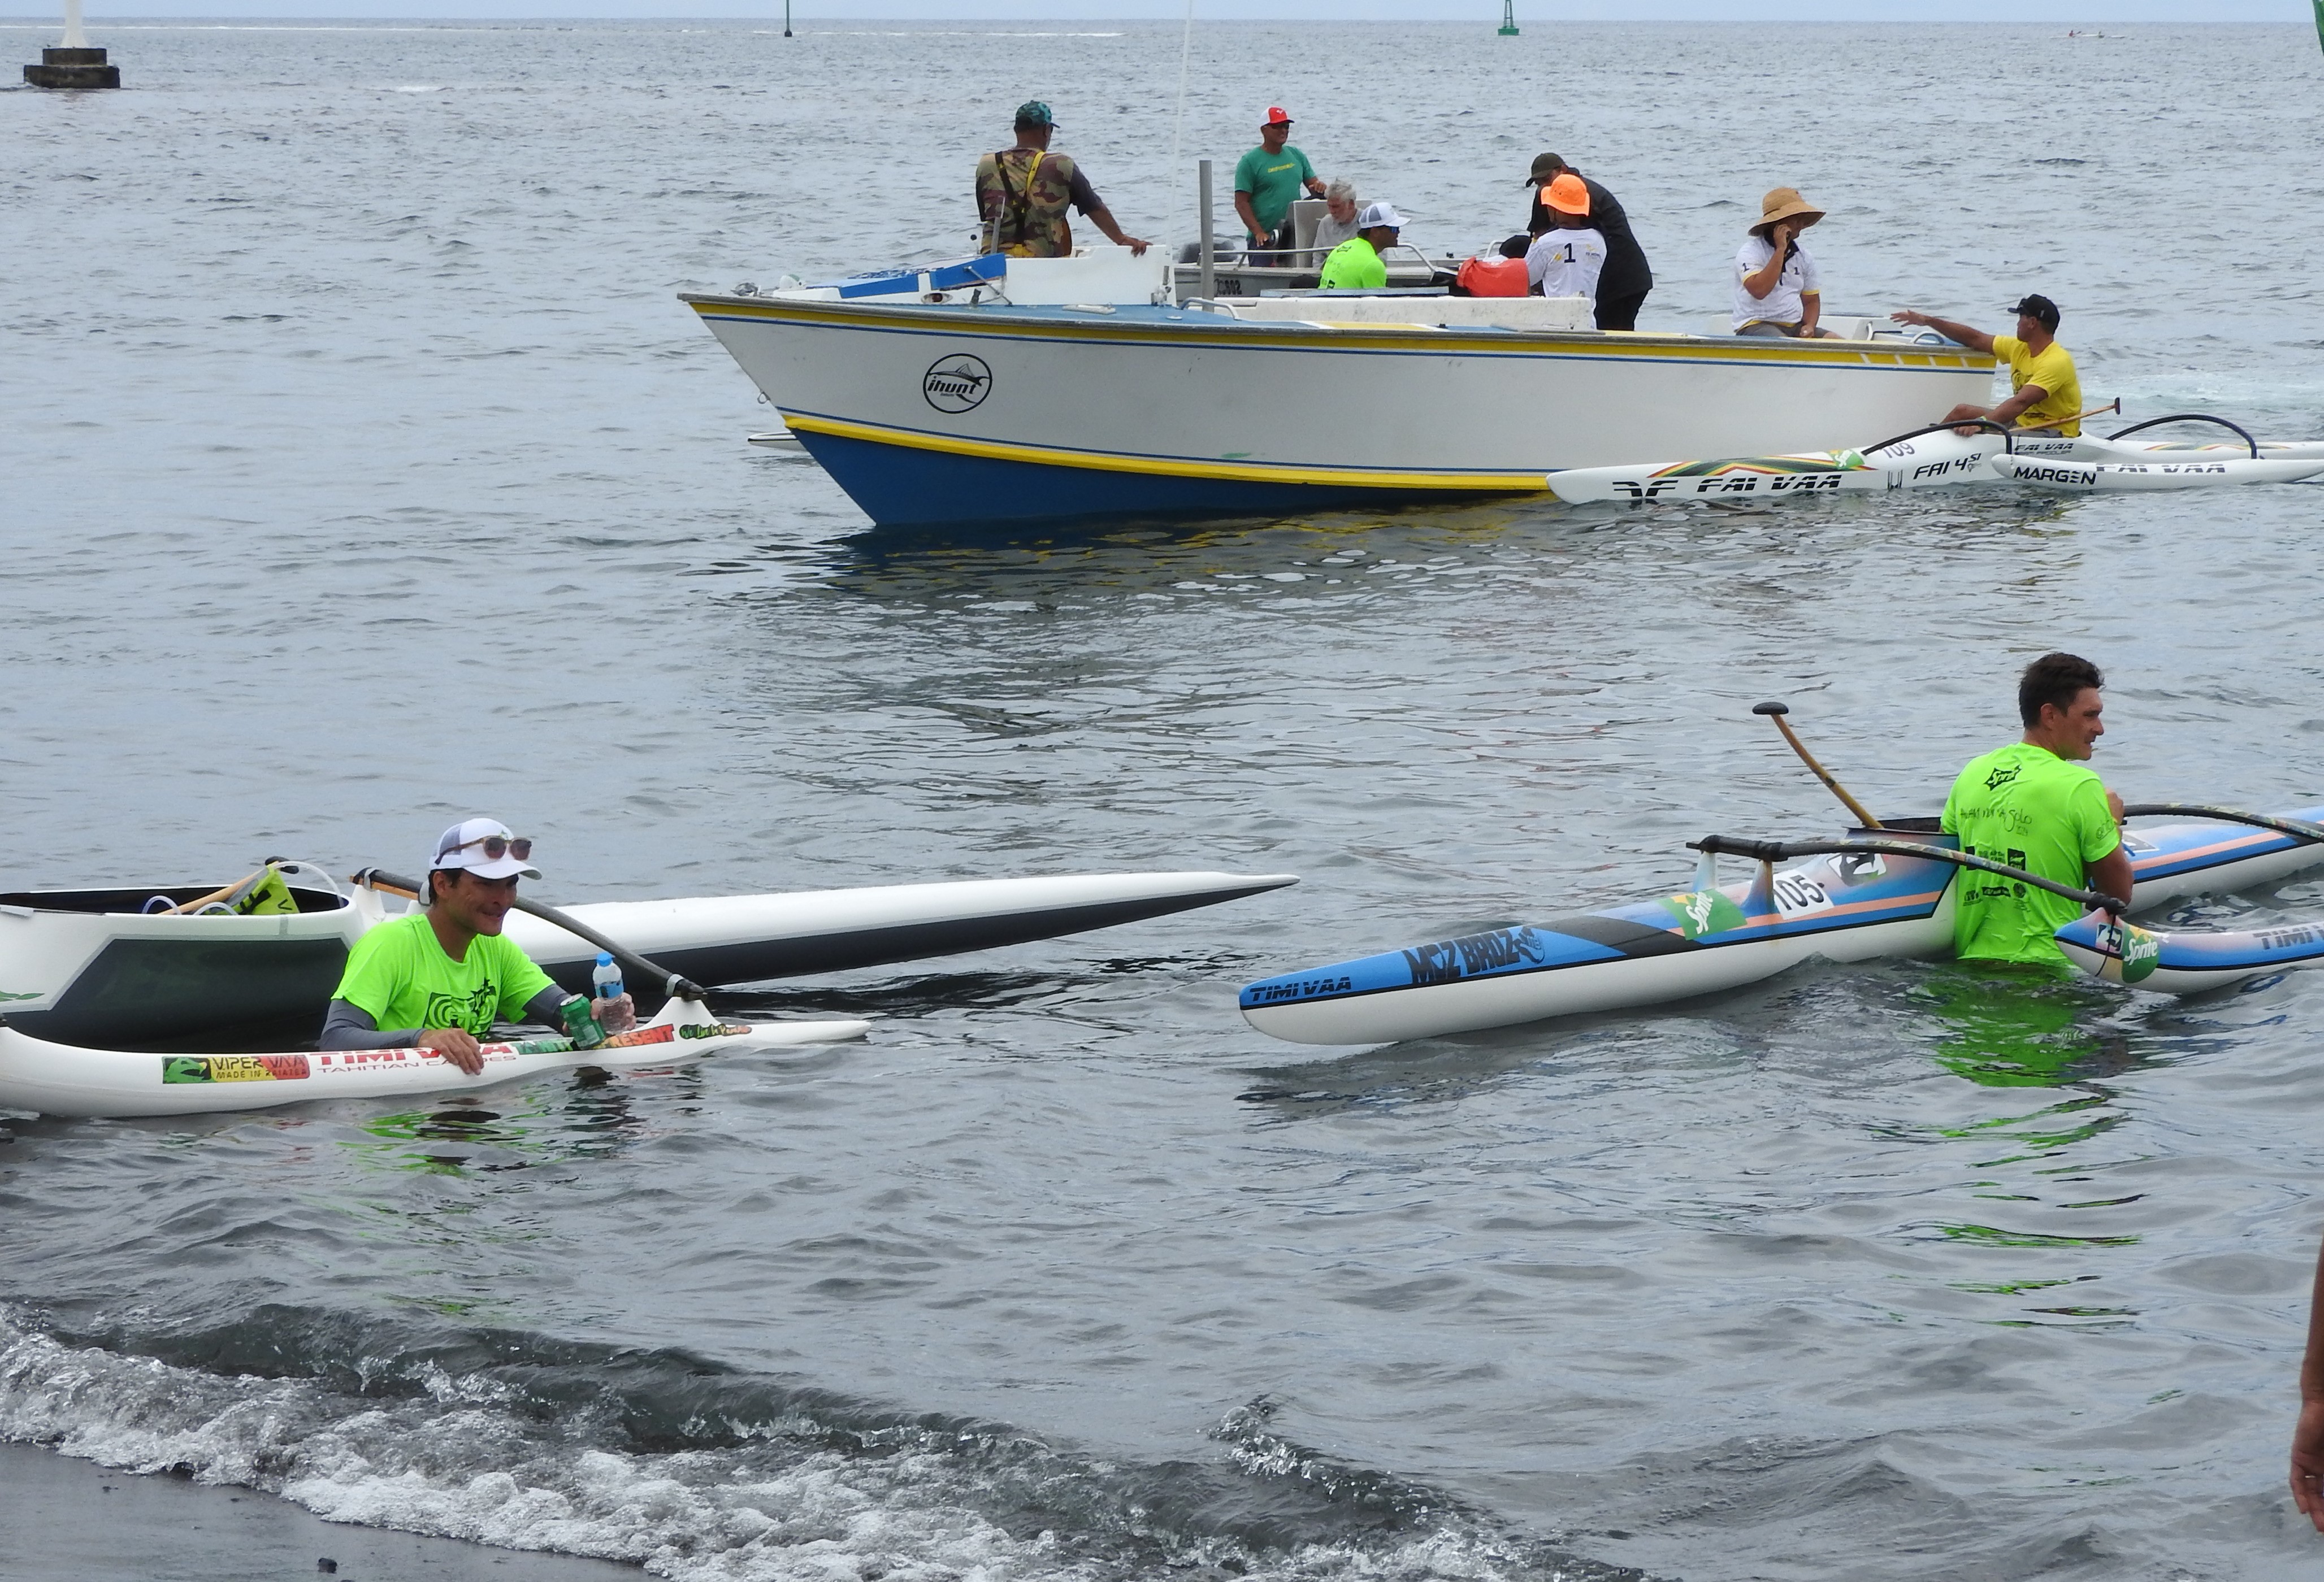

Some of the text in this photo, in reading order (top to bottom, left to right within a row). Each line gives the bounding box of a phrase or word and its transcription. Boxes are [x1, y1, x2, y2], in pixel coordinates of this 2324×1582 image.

[1564, 243, 1576, 263] 1
[1742, 262, 1750, 272] 1
[1794, 267, 1800, 275] 1
[927, 376, 976, 394] ihunt
[1913, 461, 1950, 480] FAI
[2014, 466, 2096, 485] MARGEN
[2096, 463, 2225, 473] FAI VAA
[1697, 475, 1841, 493] FAI VAA
[1773, 875, 1824, 911] 105
[2252, 927, 2314, 950] TIMI
[2124, 938, 2158, 966] Sprite
[1250, 976, 1351, 1001] TIMI VAA
[213, 1056, 264, 1070] VIPER
[310, 1042, 513, 1066] TIMI VA
[316, 1055, 517, 1074] TAHITIAN CAES
[216, 1070, 245, 1079] MADE
